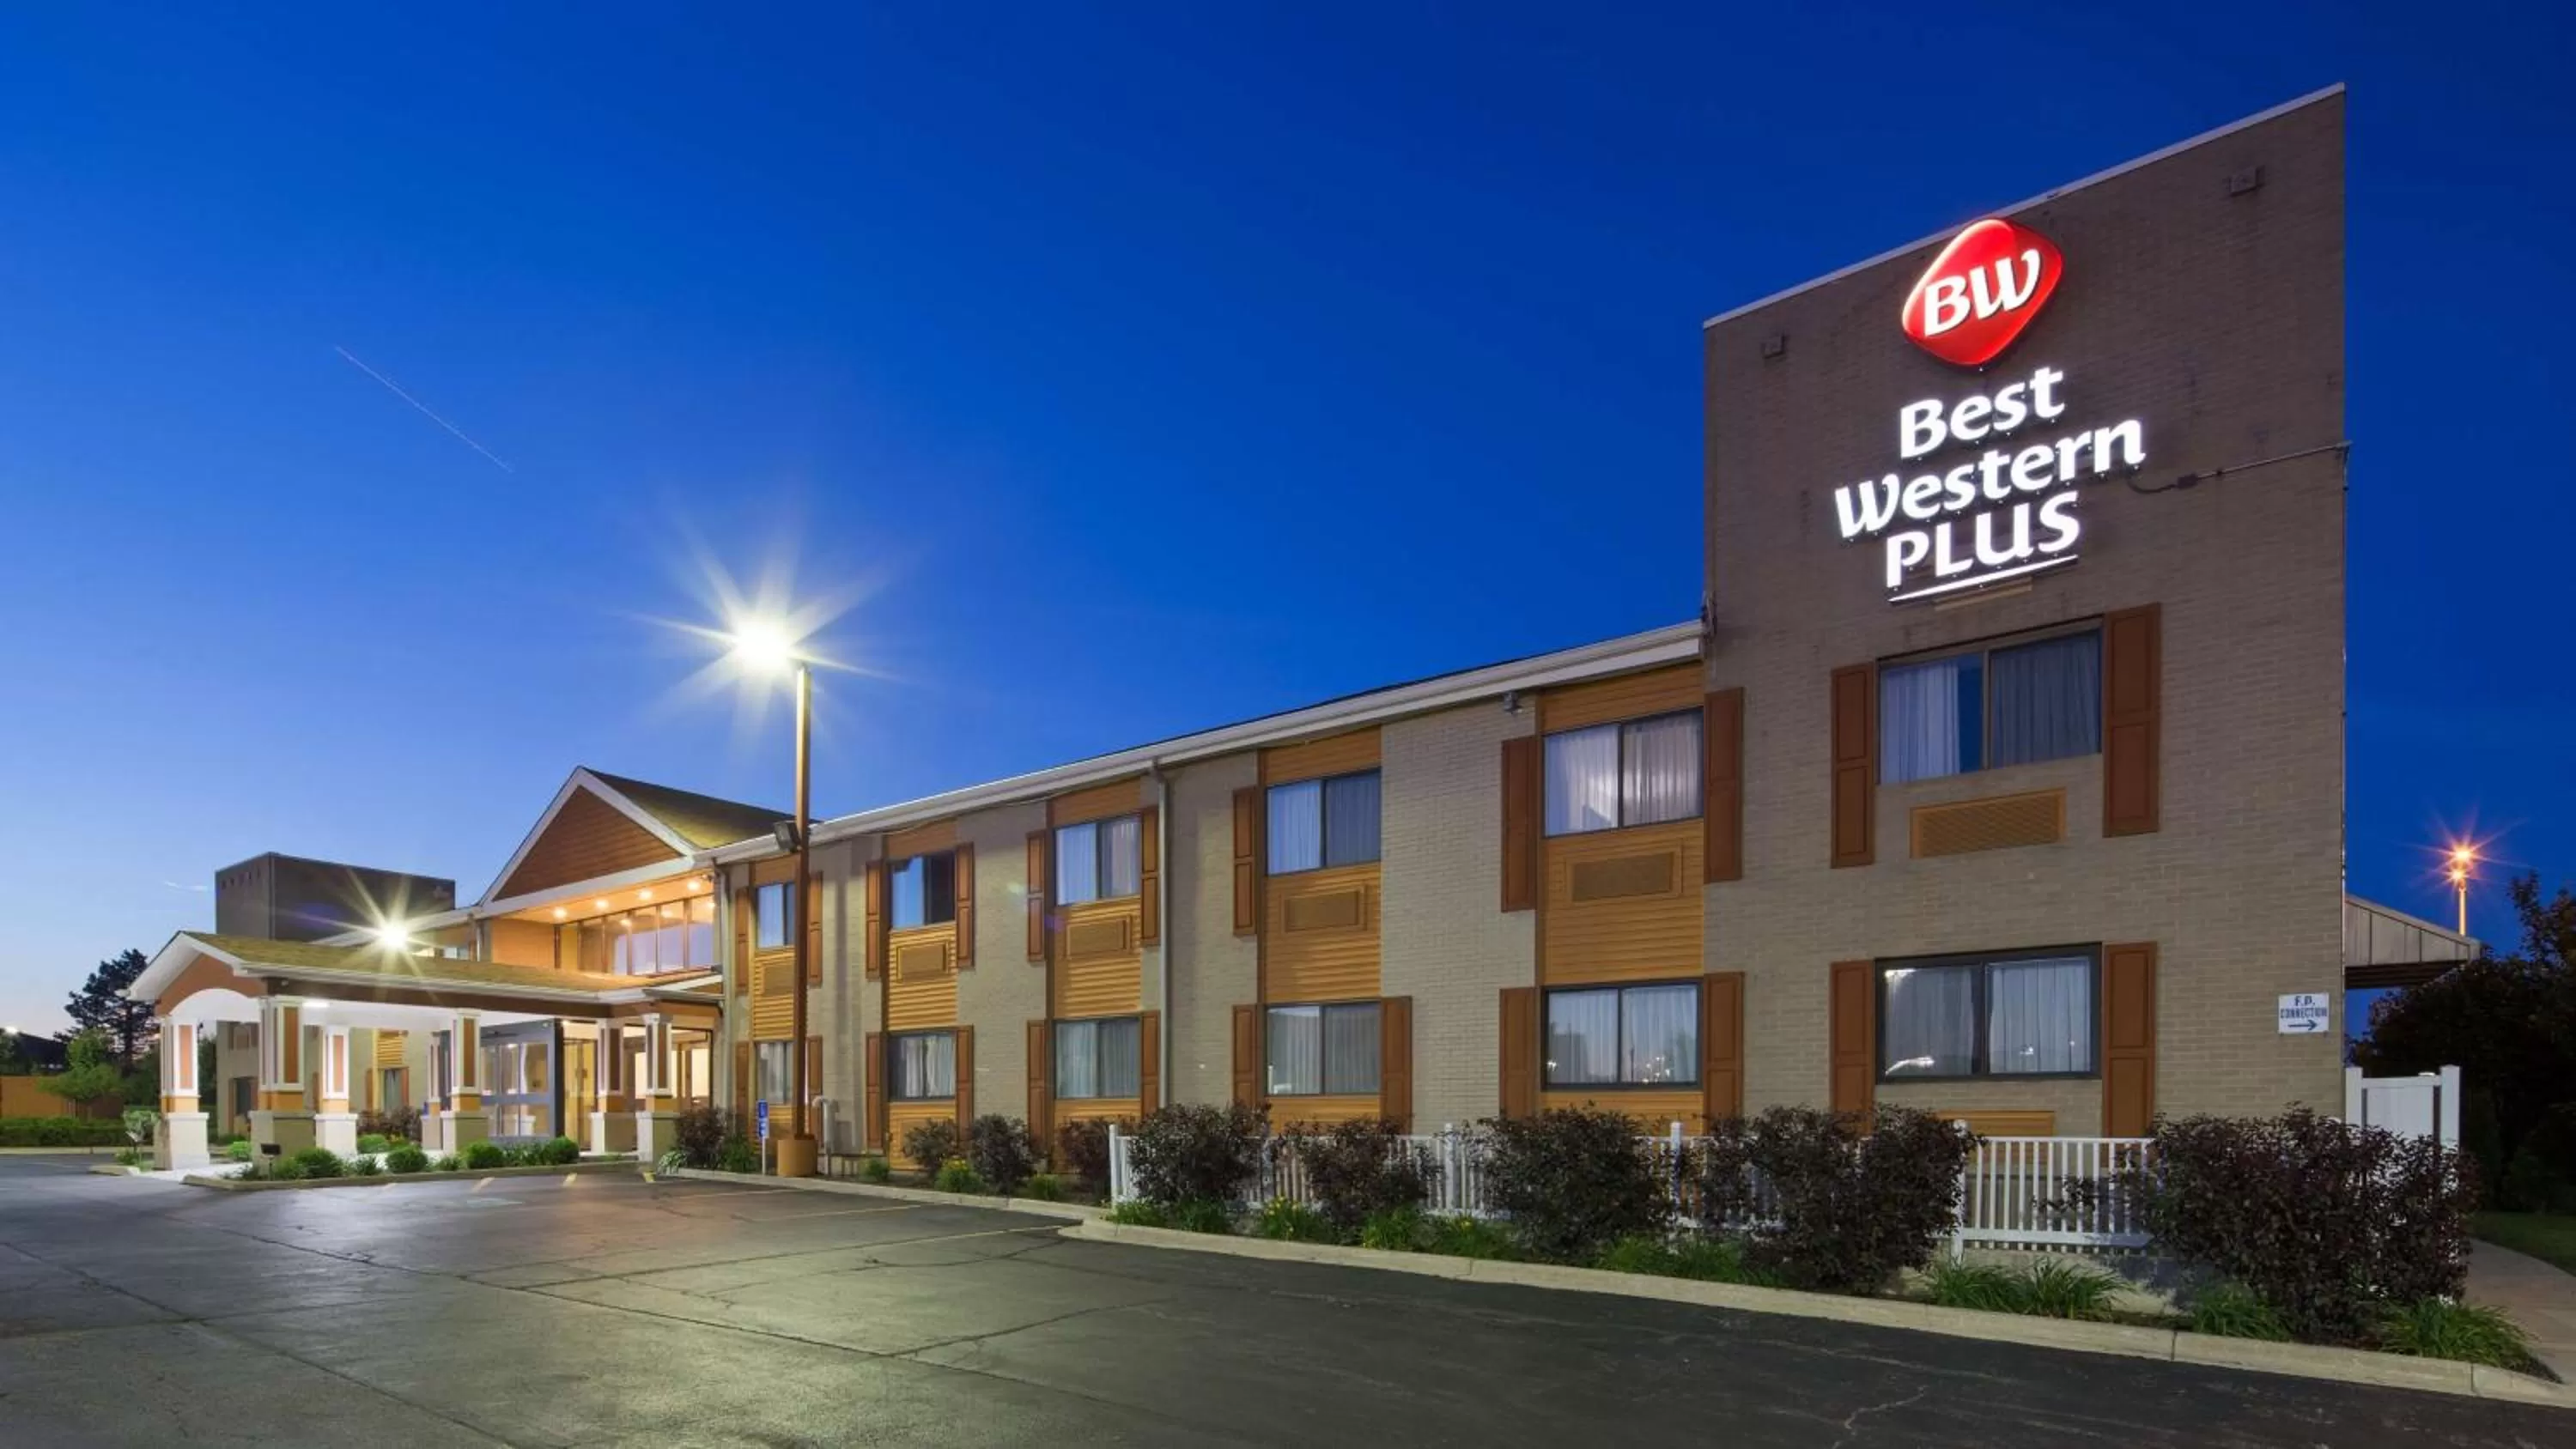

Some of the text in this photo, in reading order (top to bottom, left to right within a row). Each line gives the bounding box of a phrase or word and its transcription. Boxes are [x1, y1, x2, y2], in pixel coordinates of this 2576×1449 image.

[1923, 249, 2040, 336] BW
[1899, 367, 2065, 458] Best
[1834, 419, 2146, 538] Western
[1886, 490, 2081, 587] PLUS
